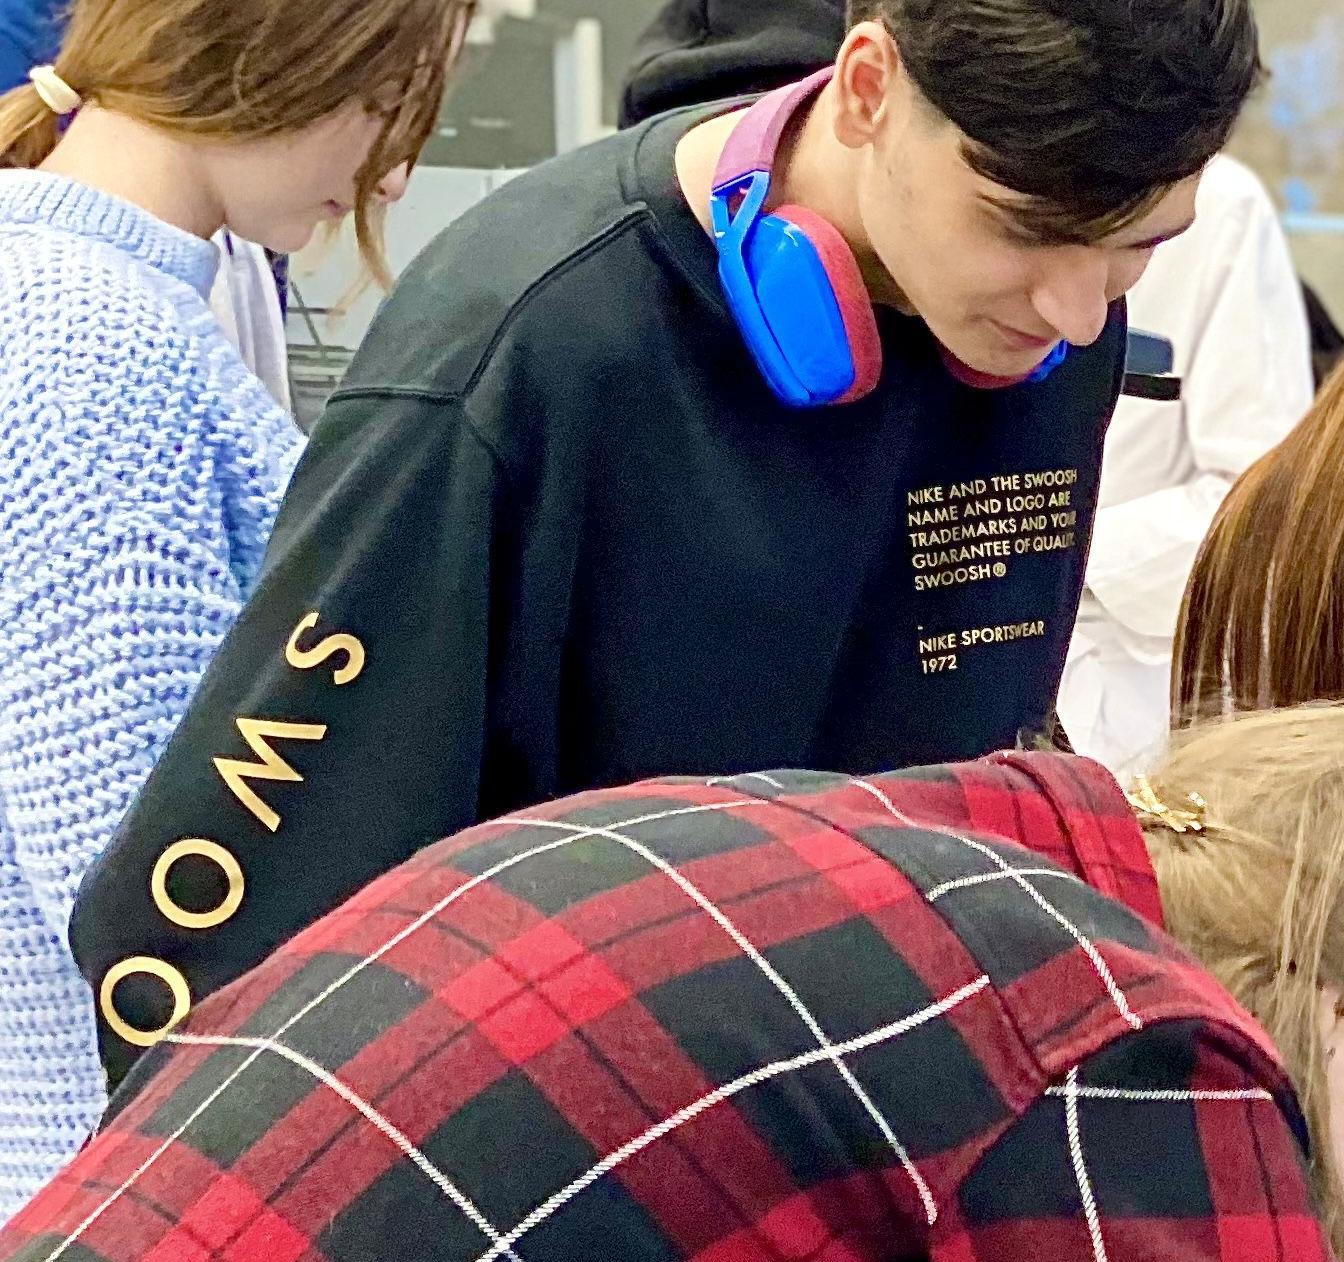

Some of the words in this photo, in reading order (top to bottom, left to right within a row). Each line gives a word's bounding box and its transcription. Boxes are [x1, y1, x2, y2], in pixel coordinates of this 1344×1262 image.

[907, 486, 943, 506] NIKE
[950, 479, 987, 499] AND
[991, 474, 1021, 491] THE
[1024, 469, 1077, 489] SWOOSH
[908, 506, 958, 527] NAME
[964, 498, 1001, 517] AND
[1006, 493, 1045, 512] LOGO
[1048, 491, 1071, 507] ARE
[909, 518, 1017, 548] TRADEMARKS
[1020, 515, 1047, 532] AND
[911, 540, 1011, 569] GUARANTEE
[1015, 537, 1031, 554] OF
[919, 633, 957, 654] NIKE
[960, 620, 1044, 646] SPORTSWEAR
[921, 654, 958, 675] 1972
